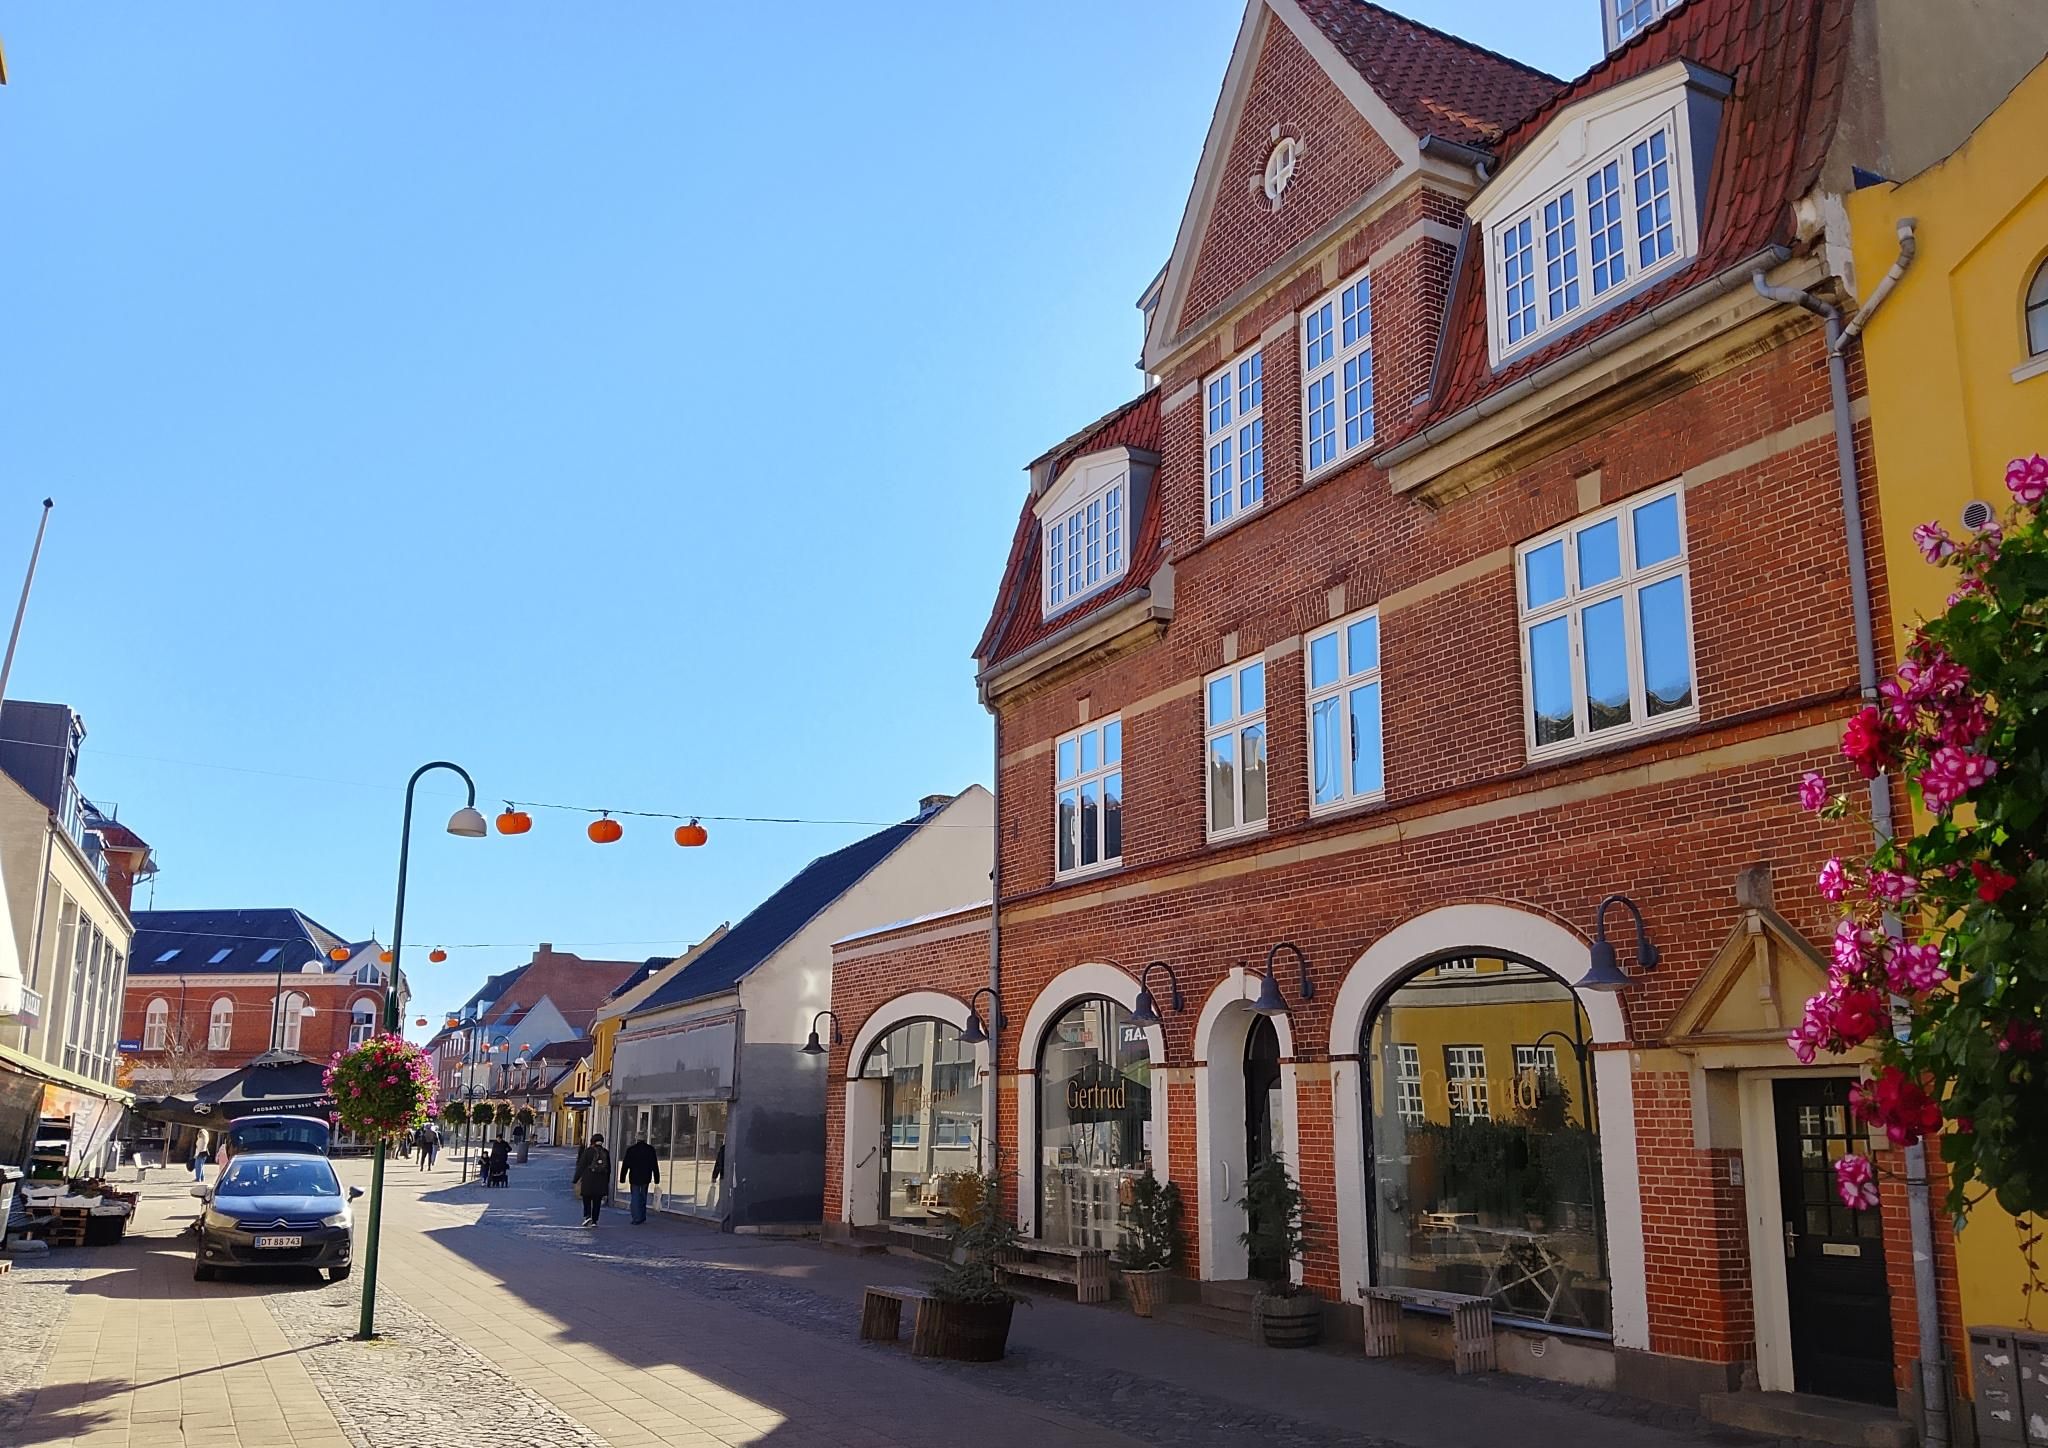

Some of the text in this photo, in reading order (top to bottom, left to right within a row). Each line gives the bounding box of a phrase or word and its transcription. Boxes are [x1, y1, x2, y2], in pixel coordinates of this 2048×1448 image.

[1066, 1078, 1126, 1110] Gertrud
[1823, 1080, 1835, 1099] 4
[252, 1105, 284, 1113] PROBABLY
[261, 1237, 300, 1246] DT 88 743
